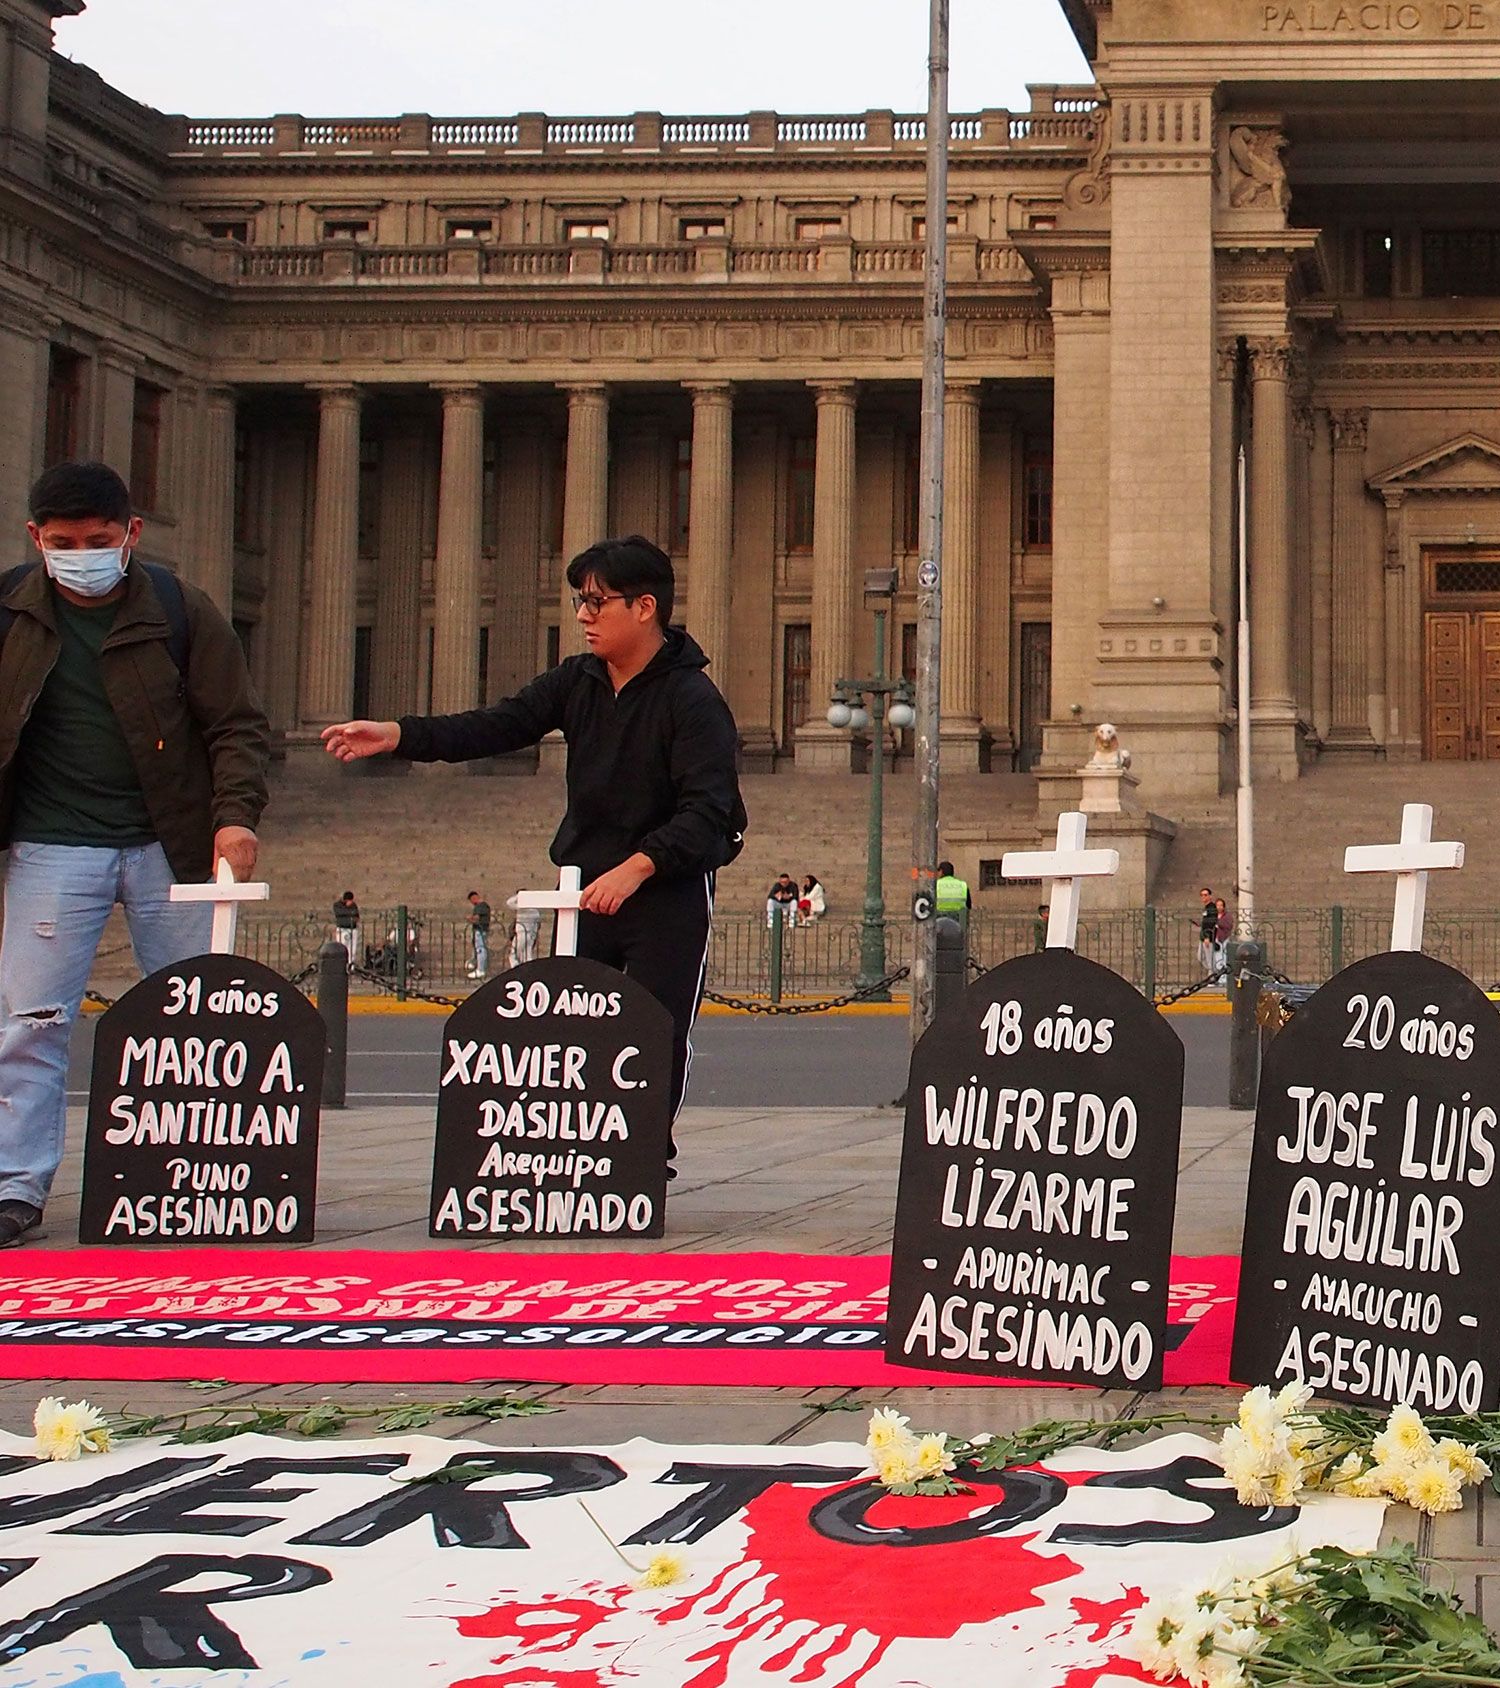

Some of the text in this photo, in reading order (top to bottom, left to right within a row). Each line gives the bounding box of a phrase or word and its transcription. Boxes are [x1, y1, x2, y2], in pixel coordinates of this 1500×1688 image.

[1262, 5, 1420, 32] PALACIO
[1443, 4, 1485, 30] DE
[164, 977, 278, 1017] 31 años
[497, 981, 548, 1017] 30
[981, 1001, 1114, 1055] 18 años
[1343, 995, 1474, 1060] 20 años
[120, 1037, 303, 1093] MARCO A.
[442, 1040, 647, 1090] XAVIER C.
[106, 1095, 299, 1145] SANTILLAN
[926, 1076, 1137, 1161] WILFREDO
[1277, 1086, 1383, 1169] JOSE
[166, 1158, 250, 1191] PUNO
[105, 1193, 297, 1235] ASESINADO
[436, 1187, 652, 1233] ASESINADO
[1284, 1175, 1463, 1274] AGUILAR
[377, 1279, 848, 1298] CAMBIOS
[954, 1247, 1110, 1305] APURIMAC
[548, 1299, 702, 1319] DE
[1302, 1273, 1441, 1336] AYACUCHO
[904, 1291, 1152, 1380] ASESINADO
[1275, 1325, 1484, 1415] ASESINADO
